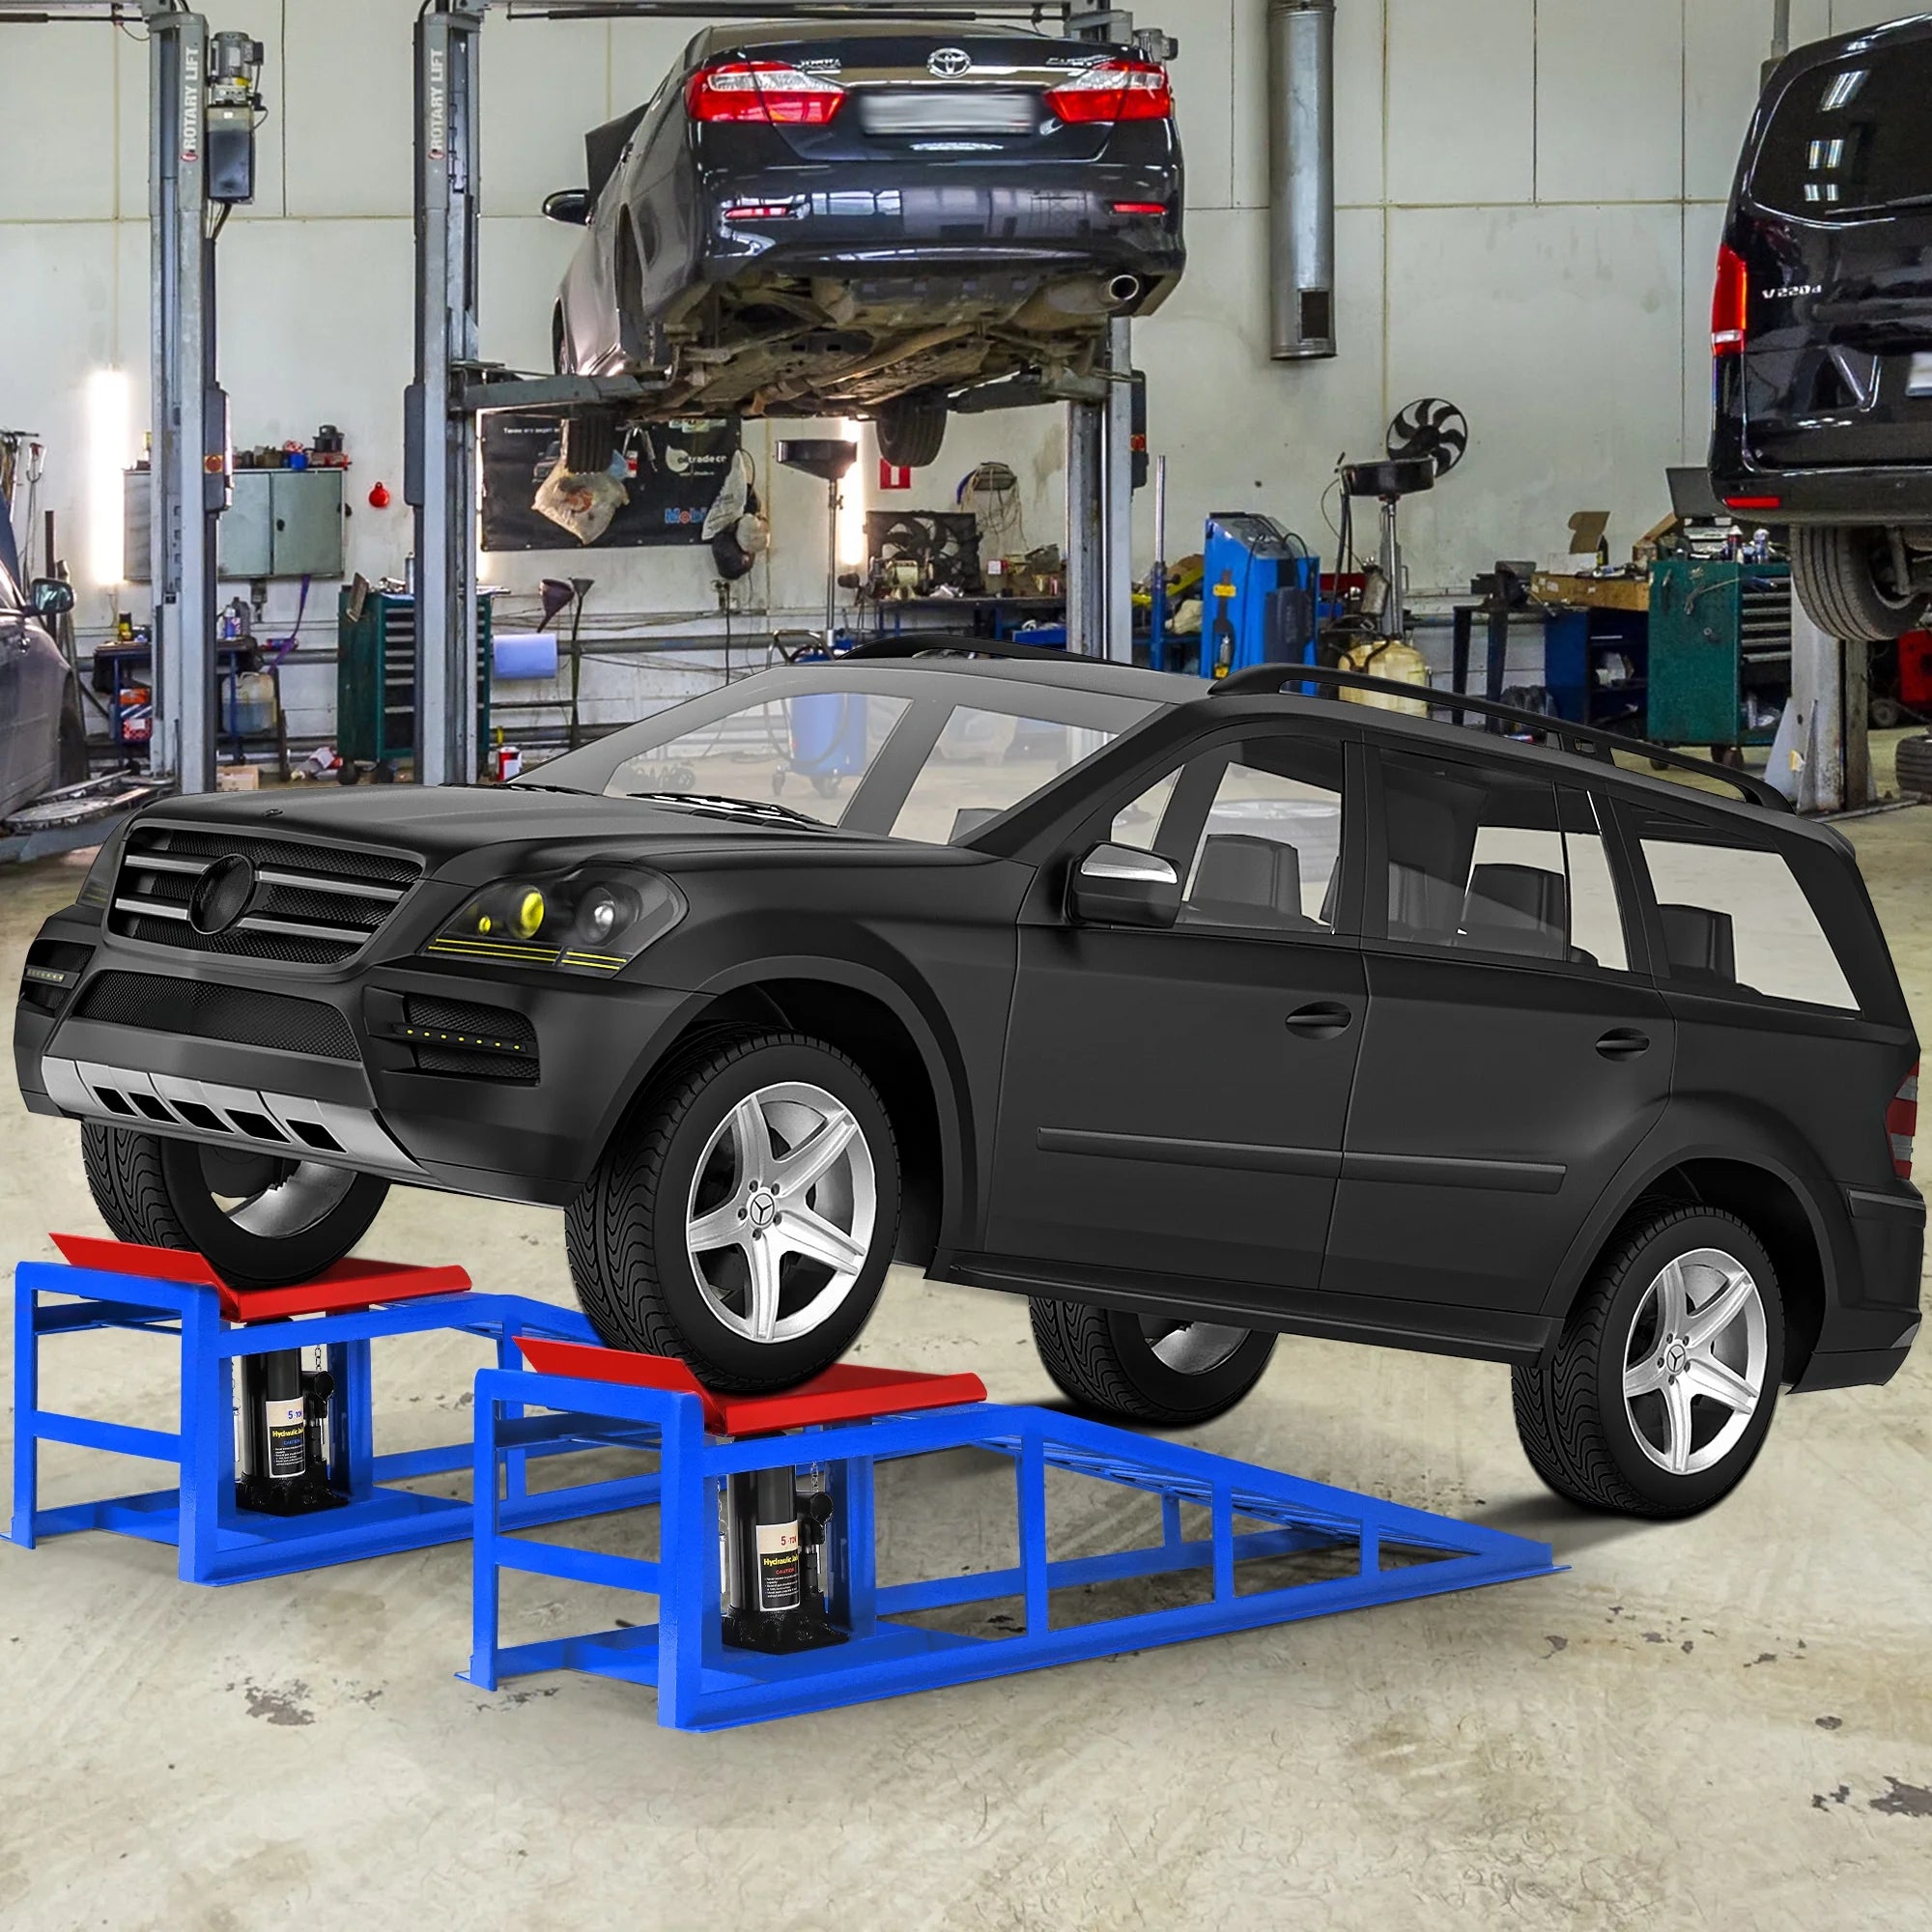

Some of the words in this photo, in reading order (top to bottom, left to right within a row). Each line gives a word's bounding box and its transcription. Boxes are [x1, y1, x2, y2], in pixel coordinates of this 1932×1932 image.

[185, 46, 199, 80] LIFT
[430, 48, 443, 82] LIFT
[183, 85, 198, 151] ROTARY
[430, 87, 443, 151] ROTARY
[665, 507, 707, 525] Mobi
[288, 1410, 294, 1420] 5
[781, 1535, 786, 1546] 5
[763, 1556, 792, 1567] Hydraulic
